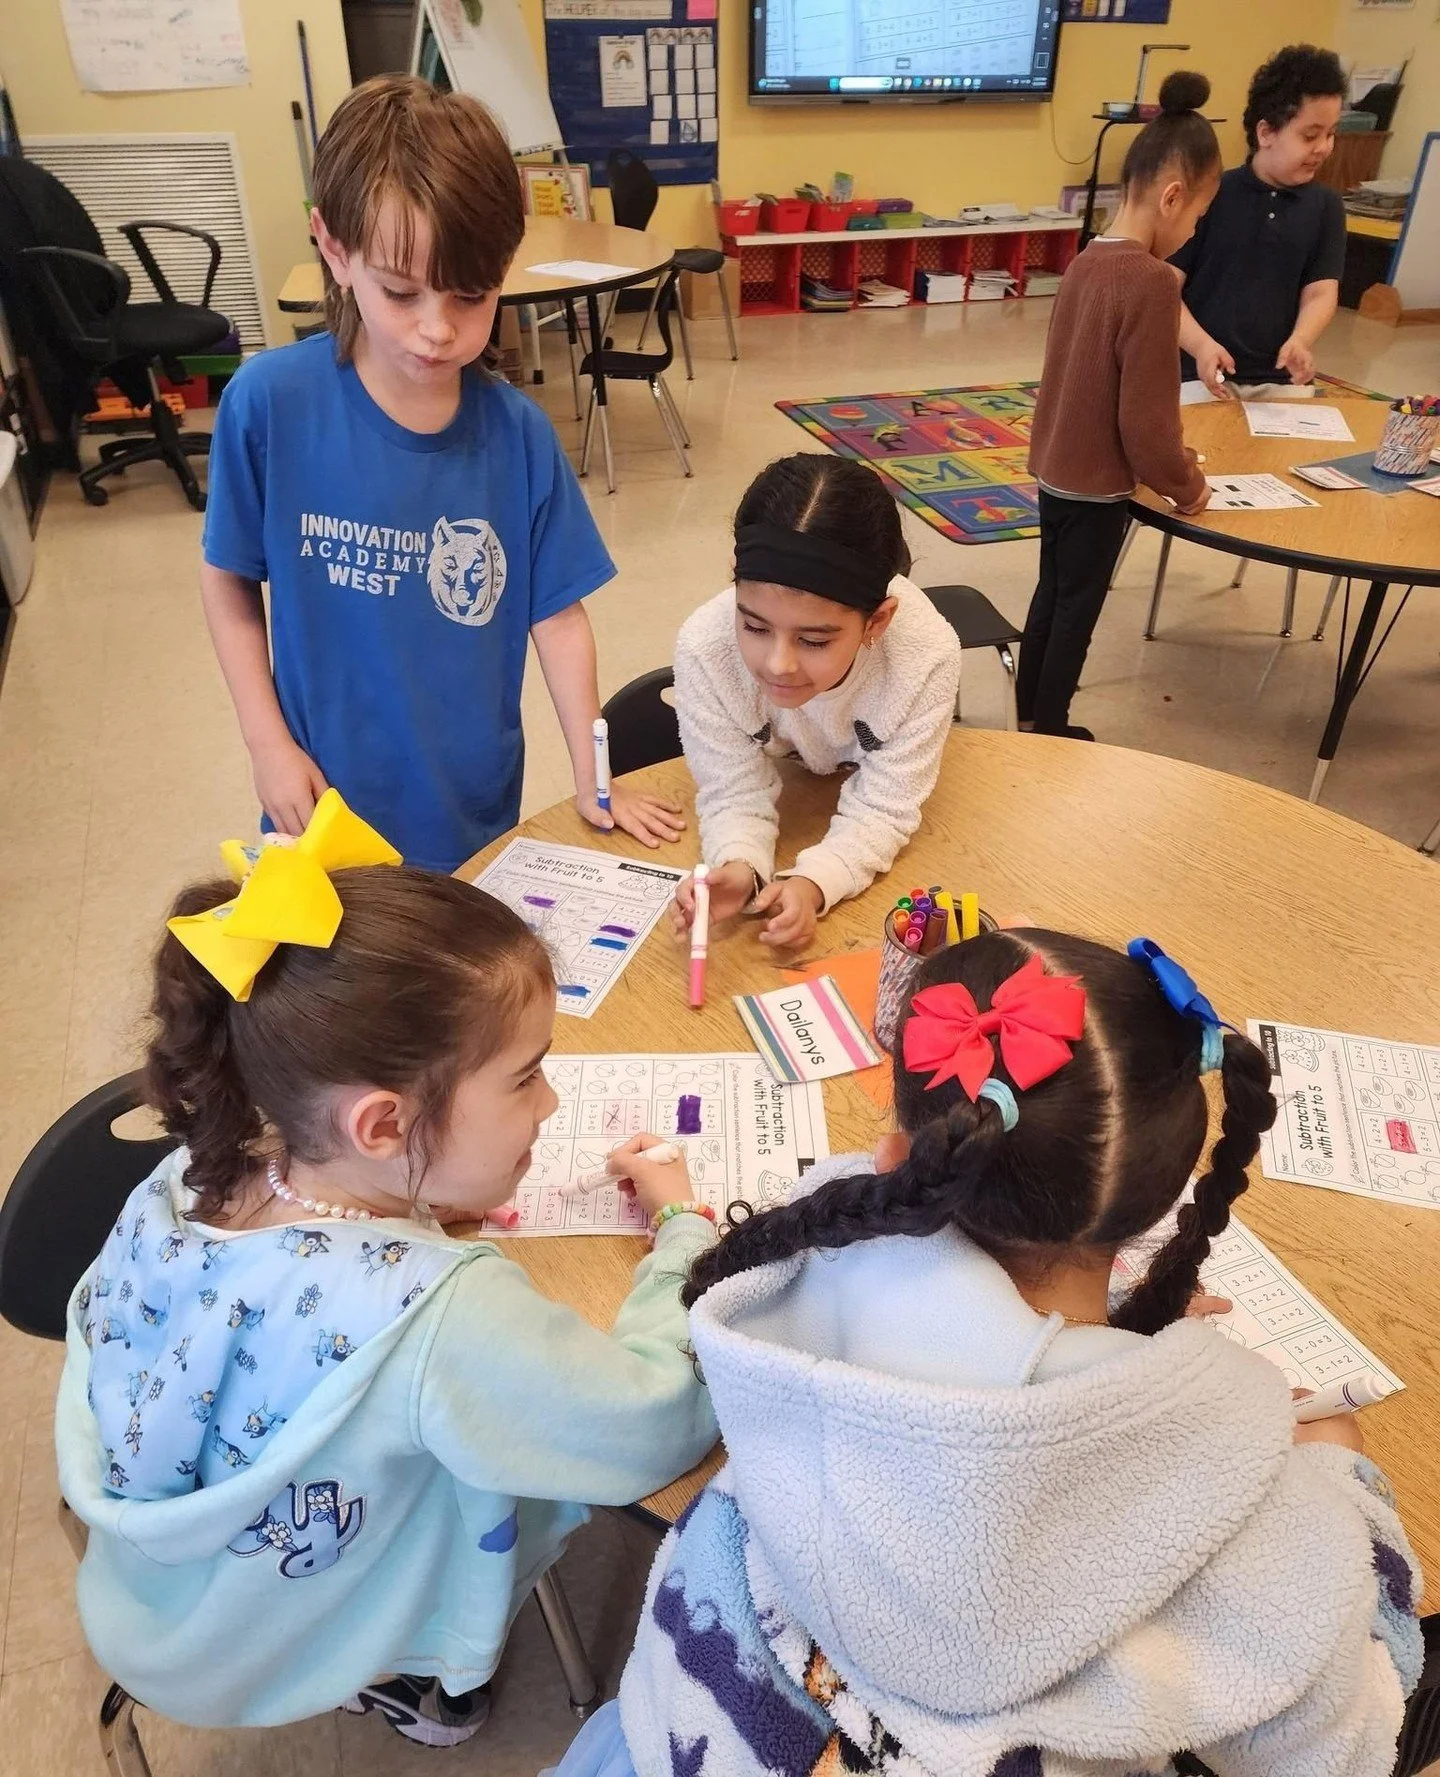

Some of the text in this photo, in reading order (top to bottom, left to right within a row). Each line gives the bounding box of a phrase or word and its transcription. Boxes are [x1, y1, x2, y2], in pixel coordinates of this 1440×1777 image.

[891, 459, 979, 485] M
[301, 513, 427, 554] INNOVATION
[300, 539, 429, 573] ACADEMY
[327, 563, 401, 596] WEST
[524, 862, 548, 872] with
[550, 866, 579, 877] Fruit
[580, 873, 593, 881] to
[535, 856, 600, 875] Subtraction
[780, 999, 825, 1065] Dailanys
[754, 1079, 767, 1101] with
[754, 1103, 769, 1130] Fruit
[771, 1083, 786, 1146] Subtraction
[1293, 1090, 1314, 1151] Subtraction
[1308, 1084, 1334, 1159] with Fruit to 5
[757, 1133, 770, 1145] to
